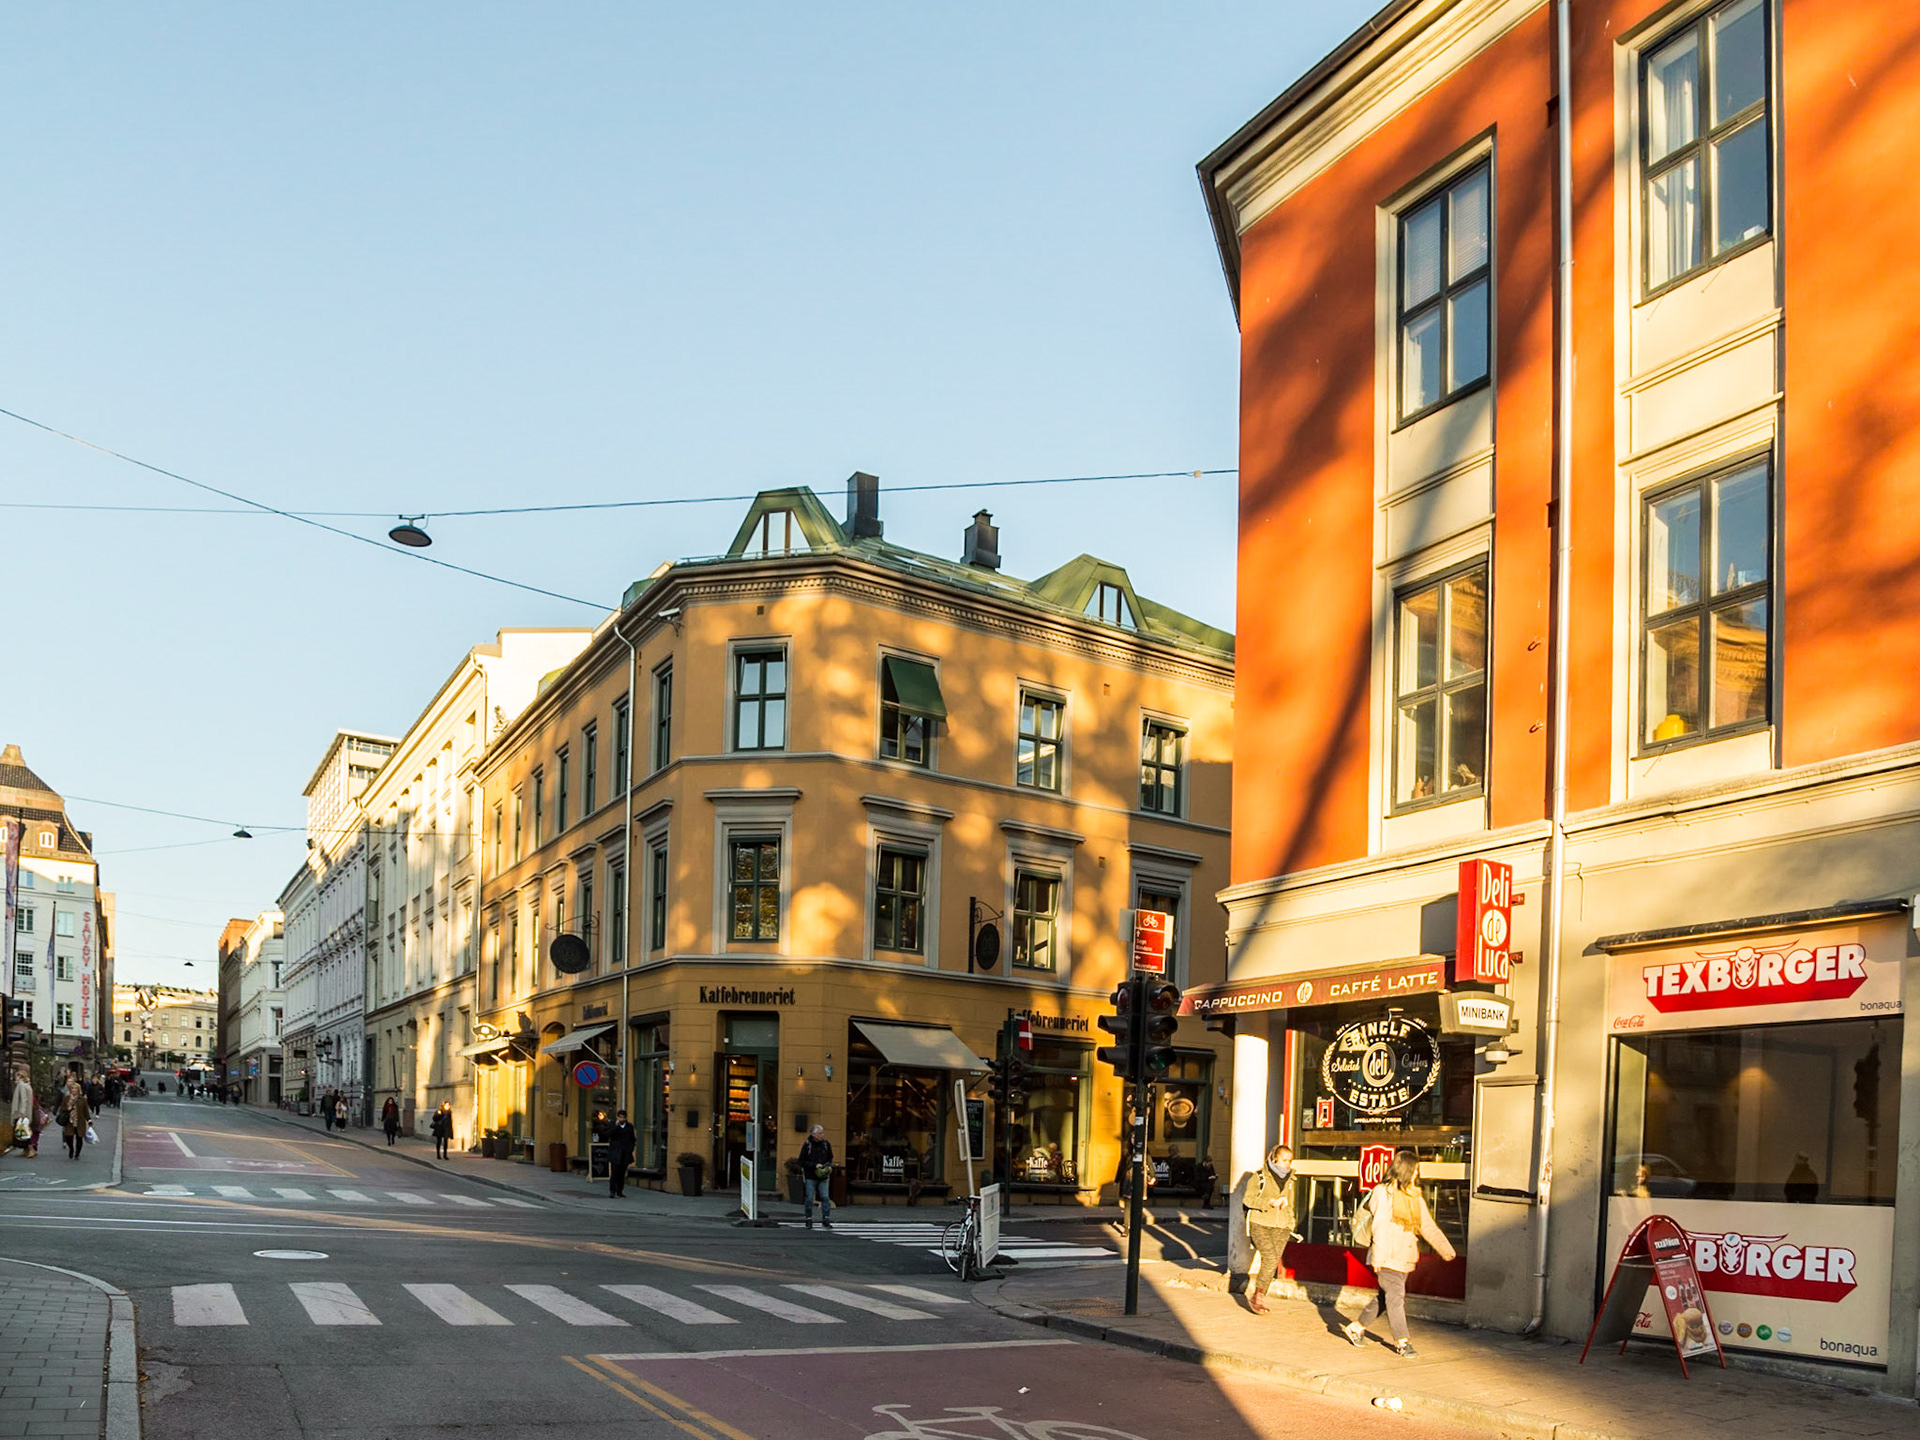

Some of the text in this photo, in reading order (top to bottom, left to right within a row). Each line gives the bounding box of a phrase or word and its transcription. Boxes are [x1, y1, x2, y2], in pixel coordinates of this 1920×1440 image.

[1481, 863, 1510, 908] Deli
[82, 911, 91, 967] SAVOY
[1477, 935, 1510, 980] Luca
[1643, 944, 1867, 997] TEXBURGER
[81, 973, 90, 1030] HOTEL
[700, 986, 795, 1005] Kaffebrenneriet
[1194, 990, 1283, 1010] CAPPUCCINO
[1330, 975, 1381, 996] CAFFÉ
[1388, 971, 1438, 989] LATTE
[1460, 1006, 1506, 1021] MINIBANK
[1860, 999, 1902, 1012] bonaqua
[1349, 1020, 1411, 1046] SINGLE
[1331, 1057, 1360, 1072] Selected
[1369, 1051, 1389, 1076] deli
[1348, 1086, 1410, 1108] ESTATE
[882, 1154, 904, 1167] Kaffe
[1029, 1156, 1048, 1169] Kaffe
[1365, 1152, 1388, 1183] deli
[1820, 1337, 1877, 1357] bonaqua
